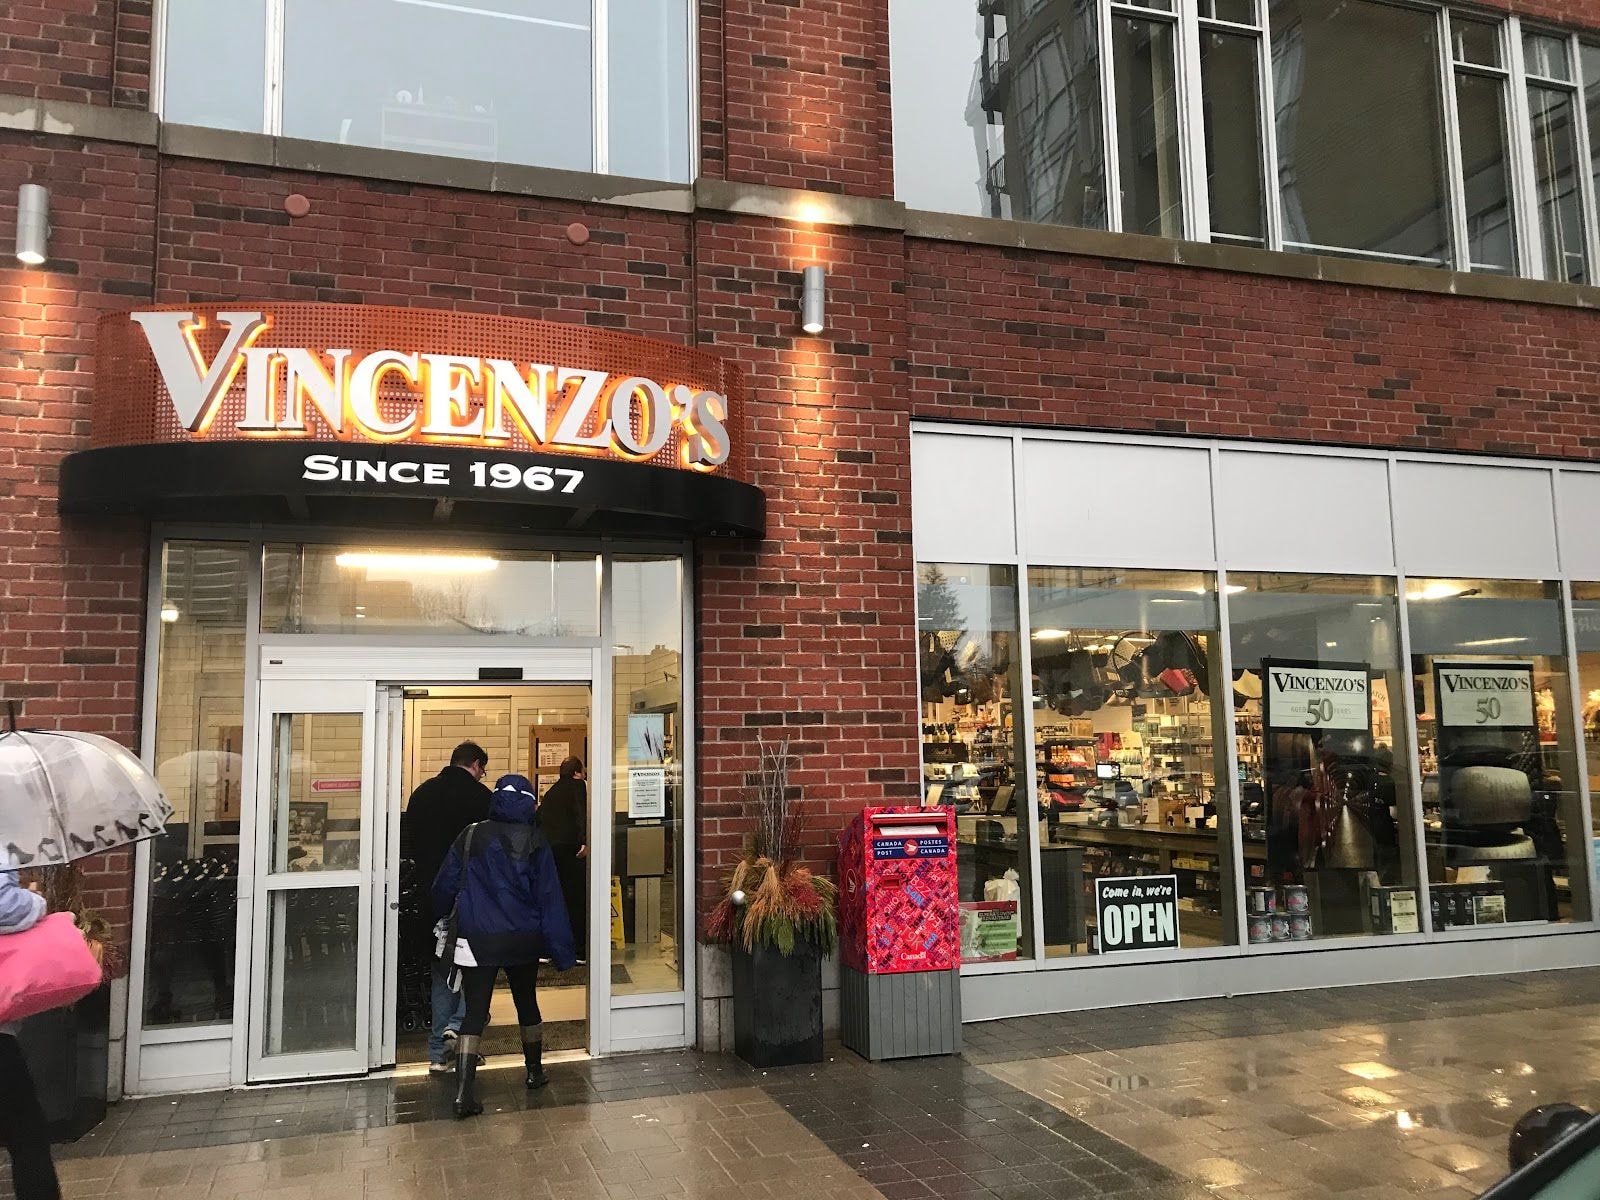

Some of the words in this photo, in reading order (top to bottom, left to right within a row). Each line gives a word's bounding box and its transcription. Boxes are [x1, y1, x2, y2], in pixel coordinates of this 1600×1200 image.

[130, 311, 731, 466] VINCENZO'S
[302, 454, 450, 486] SINCE
[469, 461, 584, 494] 1967
[1271, 672, 1366, 693] VINCENZO'S
[1442, 673, 1529, 693] VINCENZO'S
[1304, 697, 1333, 726] 50
[1475, 696, 1501, 724] 50
[1102, 886, 1129, 898] Come
[1132, 884, 1144, 898] in,
[1146, 884, 1172, 897] we're
[1103, 902, 1175, 946] OPEN
